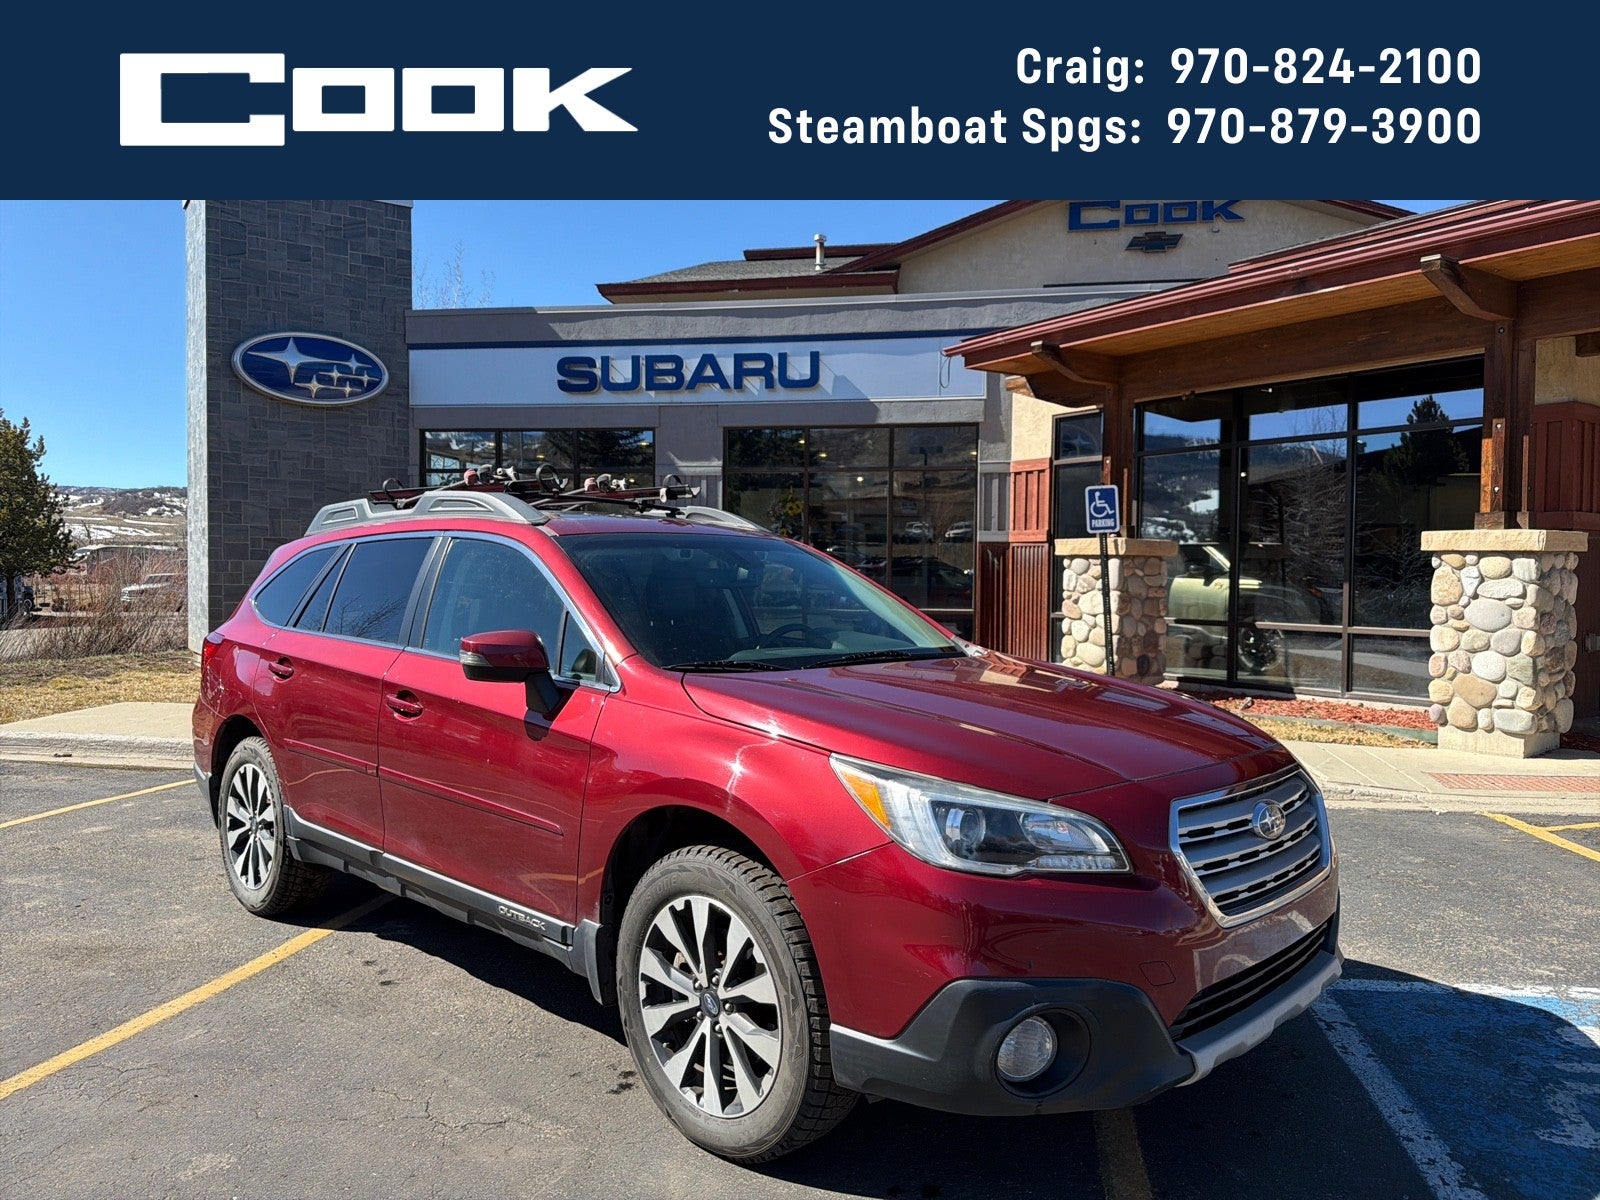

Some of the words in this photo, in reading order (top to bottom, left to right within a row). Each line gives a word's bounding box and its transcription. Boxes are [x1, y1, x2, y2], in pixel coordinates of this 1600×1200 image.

[556, 350, 820, 393] SUBARU
[1091, 518, 1115, 528] PARKING
[498, 905, 546, 931] OUTBACK
